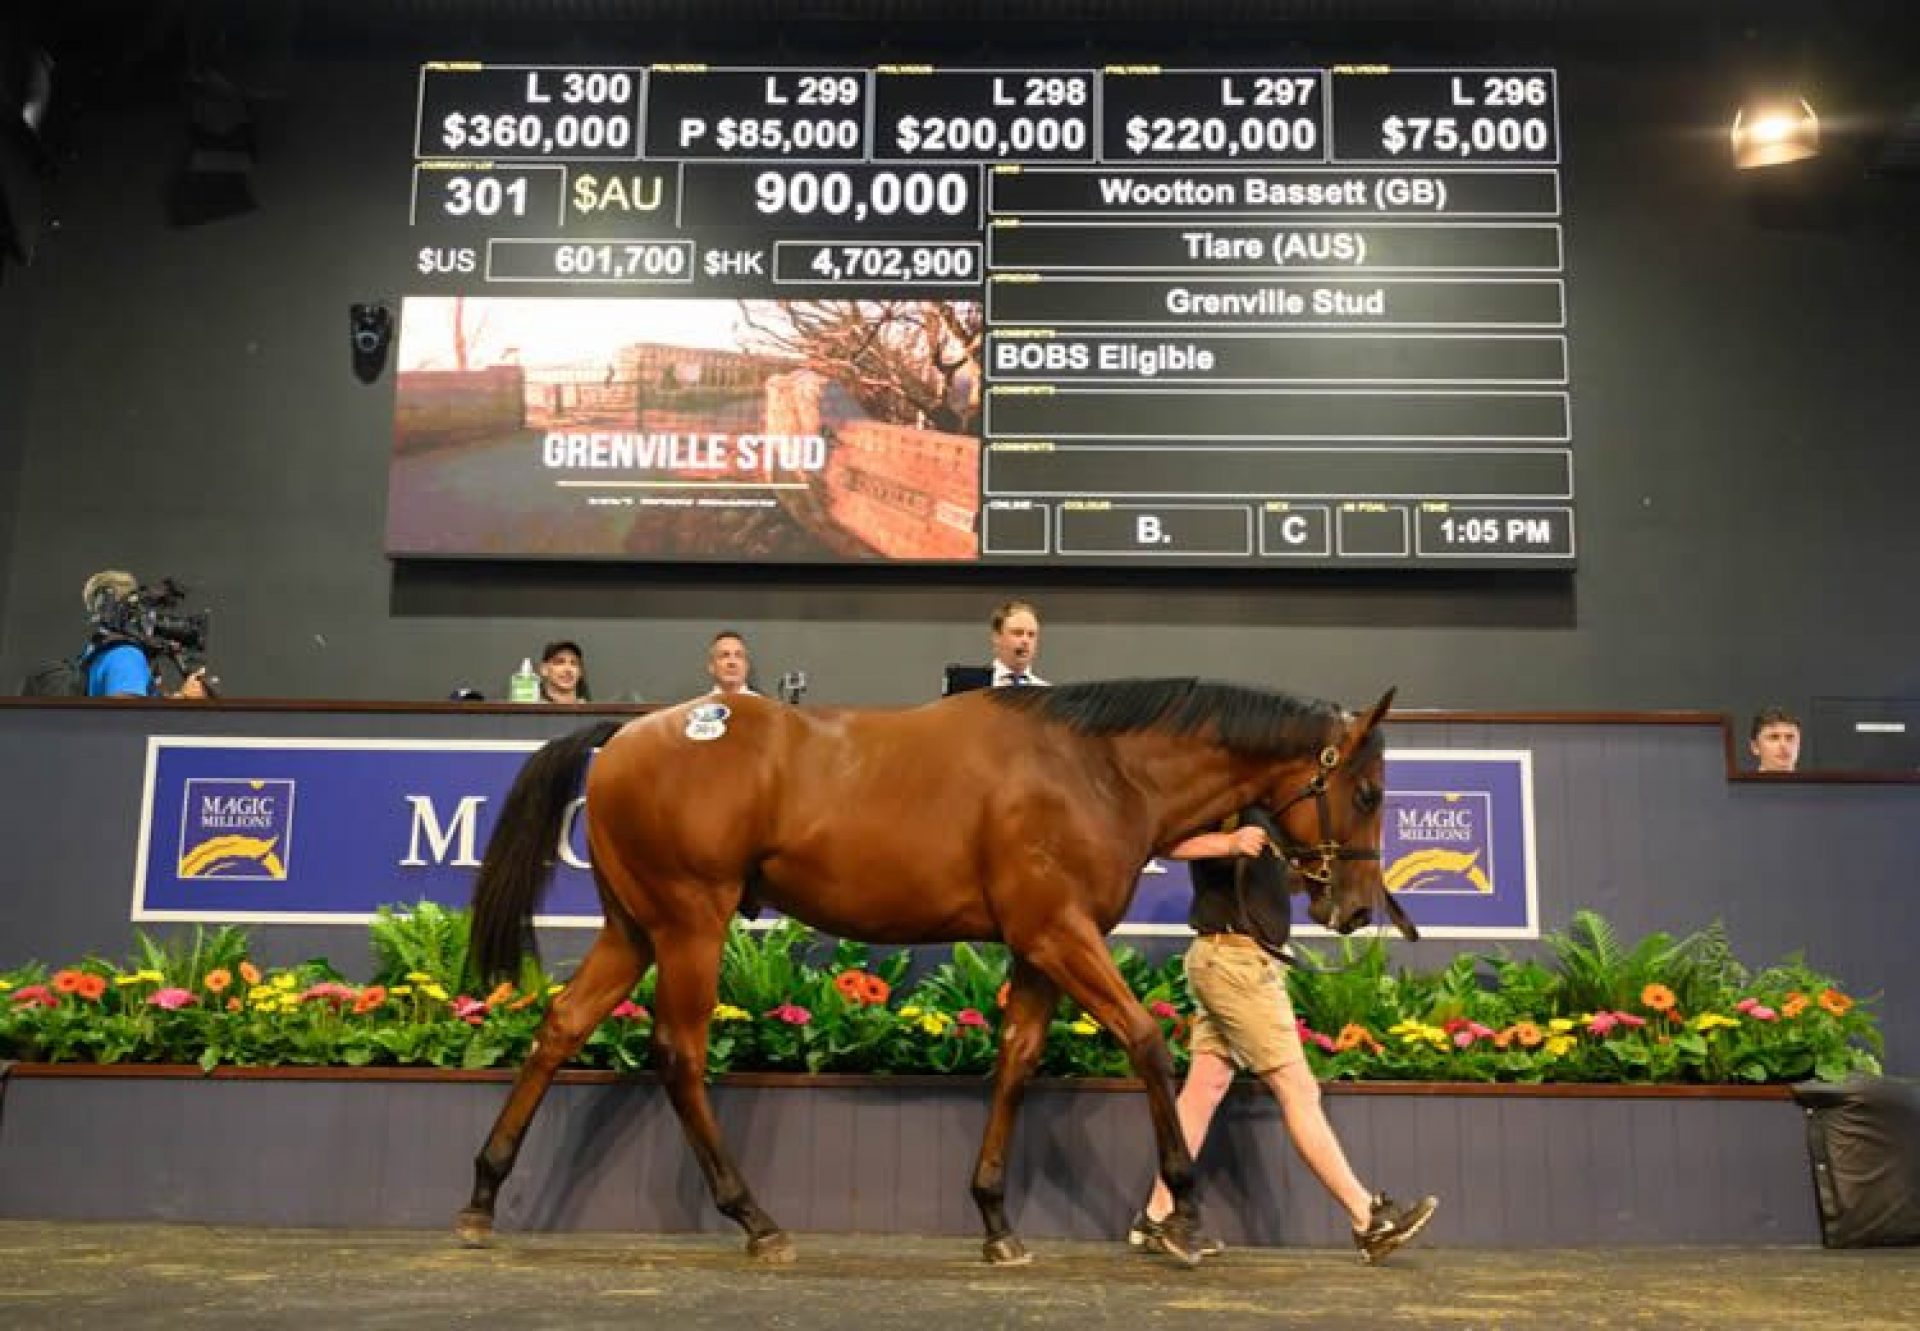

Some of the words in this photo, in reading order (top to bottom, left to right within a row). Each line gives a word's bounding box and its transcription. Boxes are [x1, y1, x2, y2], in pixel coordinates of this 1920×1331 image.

[526, 71, 551, 103] L
[562, 73, 631, 103] 300
[767, 76, 787, 104] L
[798, 76, 858, 106] 299
[993, 78, 1015, 106] L
[1025, 78, 1086, 106] 298
[1223, 78, 1245, 106] L
[1254, 78, 1315, 106] 297
[1453, 78, 1475, 106] L
[1484, 78, 1545, 106] 296
[442, 112, 629, 152] $360,000
[680, 119, 705, 147] P
[716, 117, 858, 152] $85,000
[897, 115, 1086, 157] $200,000
[1126, 116, 1316, 157] $220,000
[1382, 115, 1547, 157] $75,000
[444, 178, 526, 216] 301
[573, 173, 662, 214] $AU
[755, 171, 968, 221] 900,000
[1100, 178, 1235, 205] Wootton
[1246, 178, 1368, 205] Bassett
[1374, 178, 1447, 211] (GB)
[419, 247, 475, 273] $US
[554, 244, 684, 279] 601,700
[703, 250, 764, 275] $HK
[811, 247, 972, 280] 4,702,900
[1182, 232, 1263, 259] Tiare
[1273, 232, 1366, 265] (AUS)
[1166, 288, 1304, 314] Grenville
[1312, 288, 1384, 314] Stud
[997, 343, 1089, 369] BOBS
[1100, 344, 1214, 375] Eligible
[544, 432, 727, 469] GRENVILLE
[737, 433, 826, 470] STUD
[1138, 516, 1171, 544] B.
[1282, 516, 1307, 544] C
[1441, 518, 1499, 543] 1:05
[1507, 519, 1550, 543] PM
[201, 796, 274, 815] MAGIC
[1398, 808, 1473, 827] MAGIC
